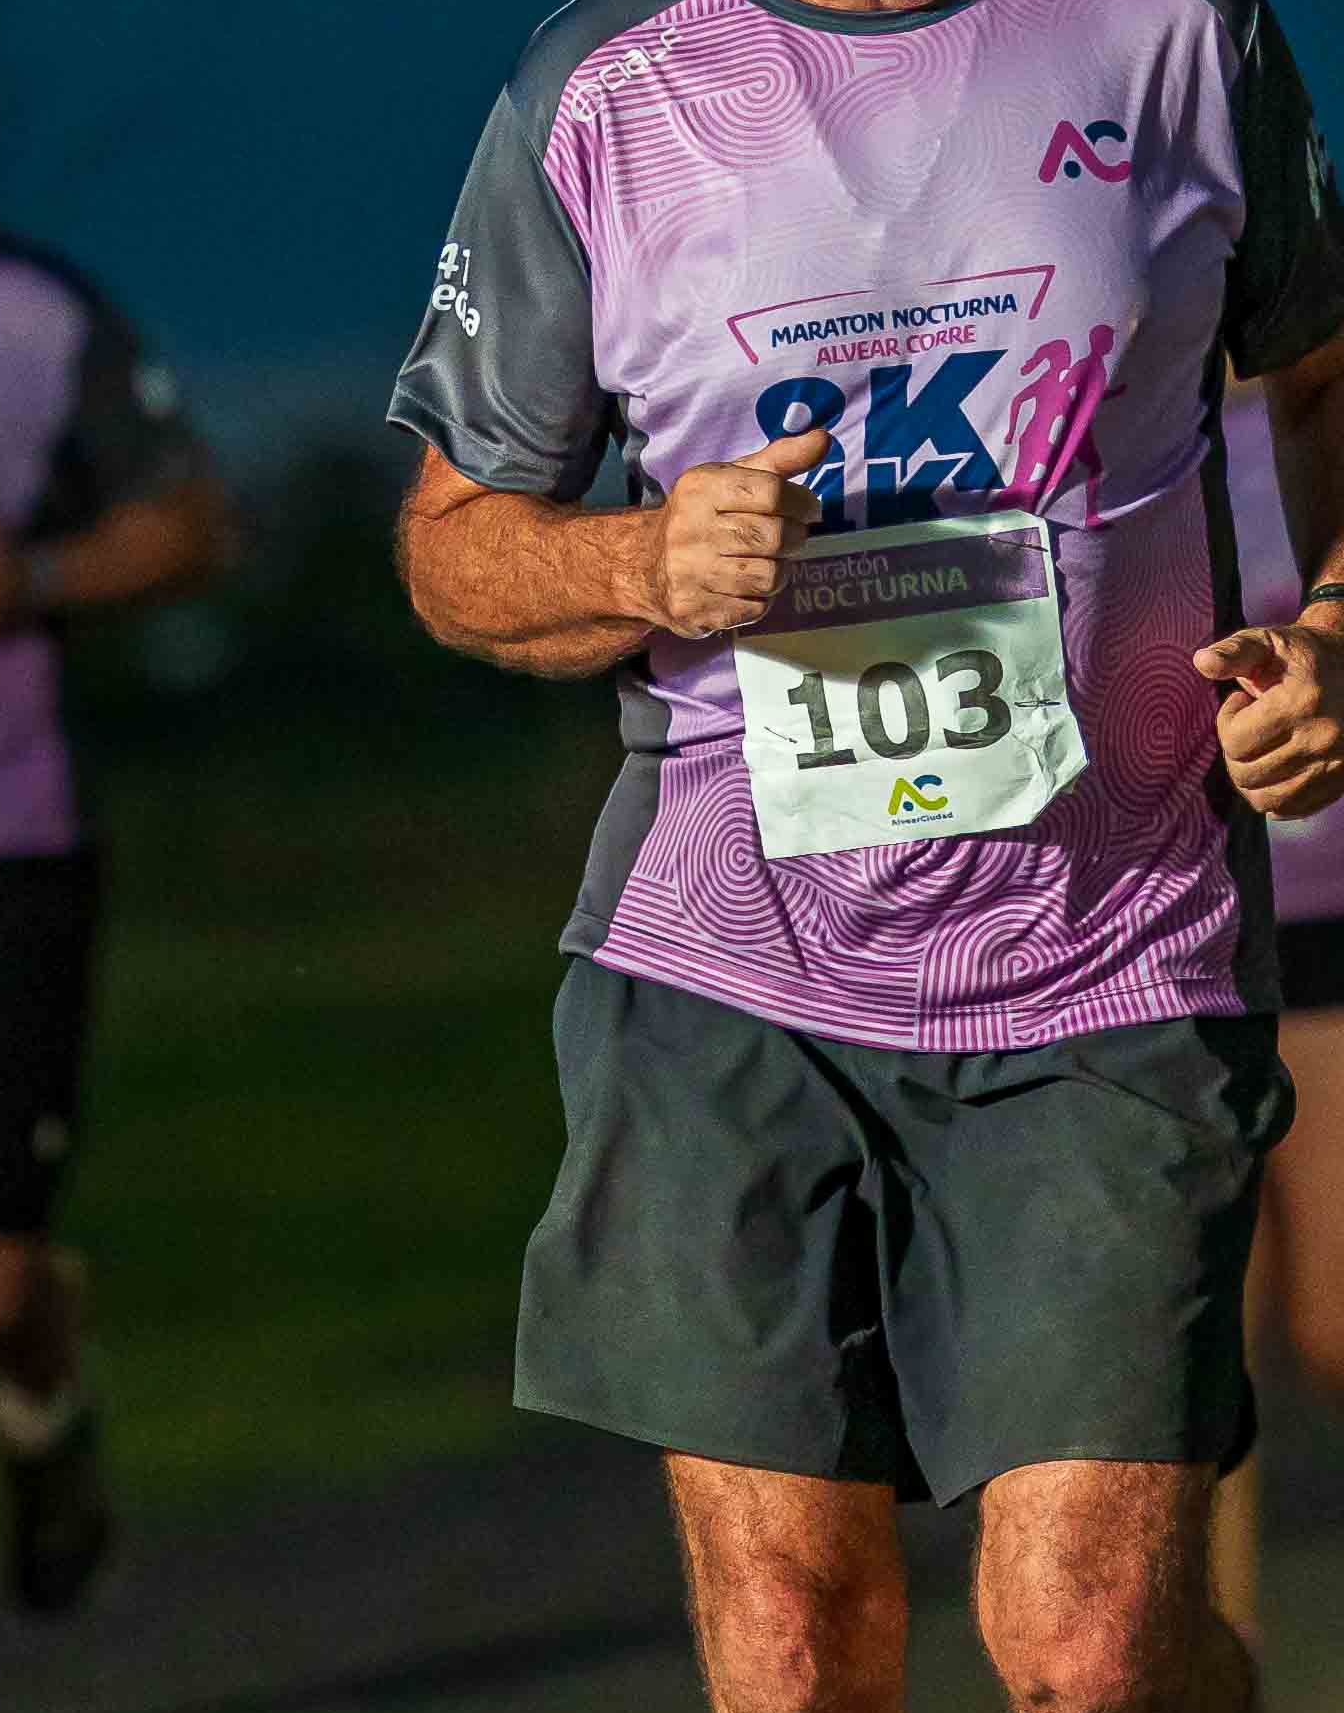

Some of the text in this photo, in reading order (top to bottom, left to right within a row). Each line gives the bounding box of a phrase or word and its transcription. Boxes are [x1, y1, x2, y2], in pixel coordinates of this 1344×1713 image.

[770, 292, 1019, 348] MARATON NOCTURNA
[816, 323, 977, 367] ALVEAR CORRE
[792, 565, 968, 615] NOCTURNA
[787, 649, 1012, 770] 103
[891, 811, 954, 827] AlvearCiudad
